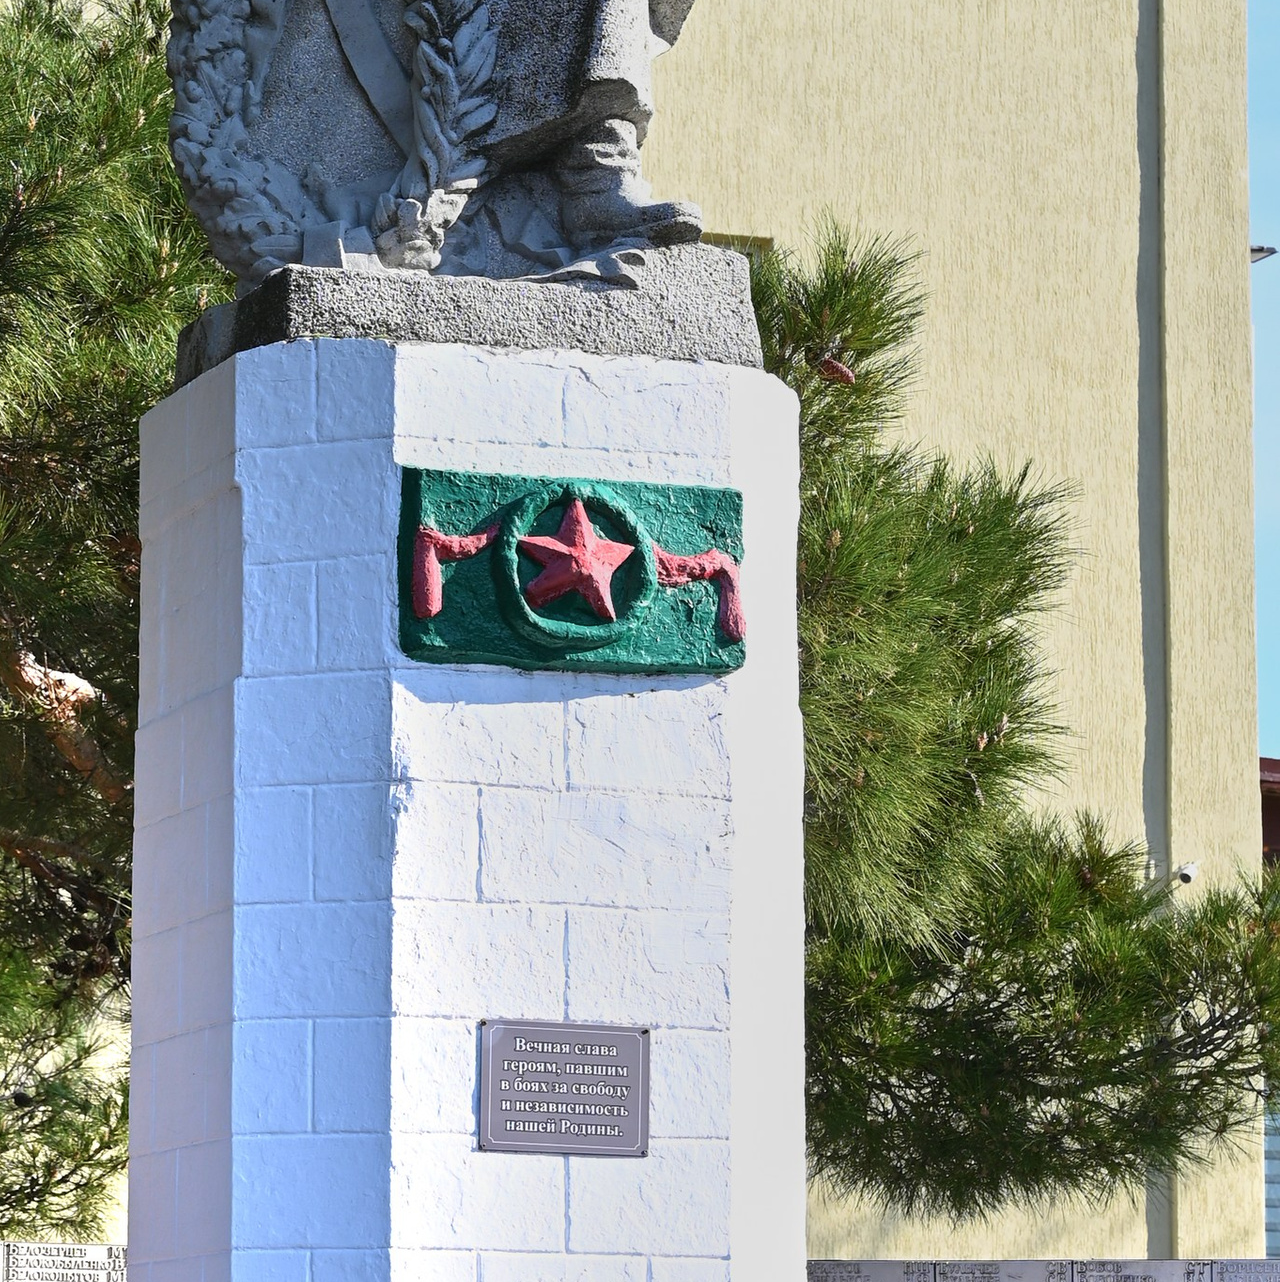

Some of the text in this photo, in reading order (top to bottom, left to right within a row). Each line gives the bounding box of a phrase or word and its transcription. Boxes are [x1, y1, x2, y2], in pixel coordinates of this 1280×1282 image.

[515, 1037, 618, 1056] Вечная слава
[503, 1060, 628, 1077] героям, павшим
[500, 1078, 630, 1099] в боях за свободу
[501, 1100, 629, 1117] и независимость
[506, 1119, 623, 1136] нашей Родины.
